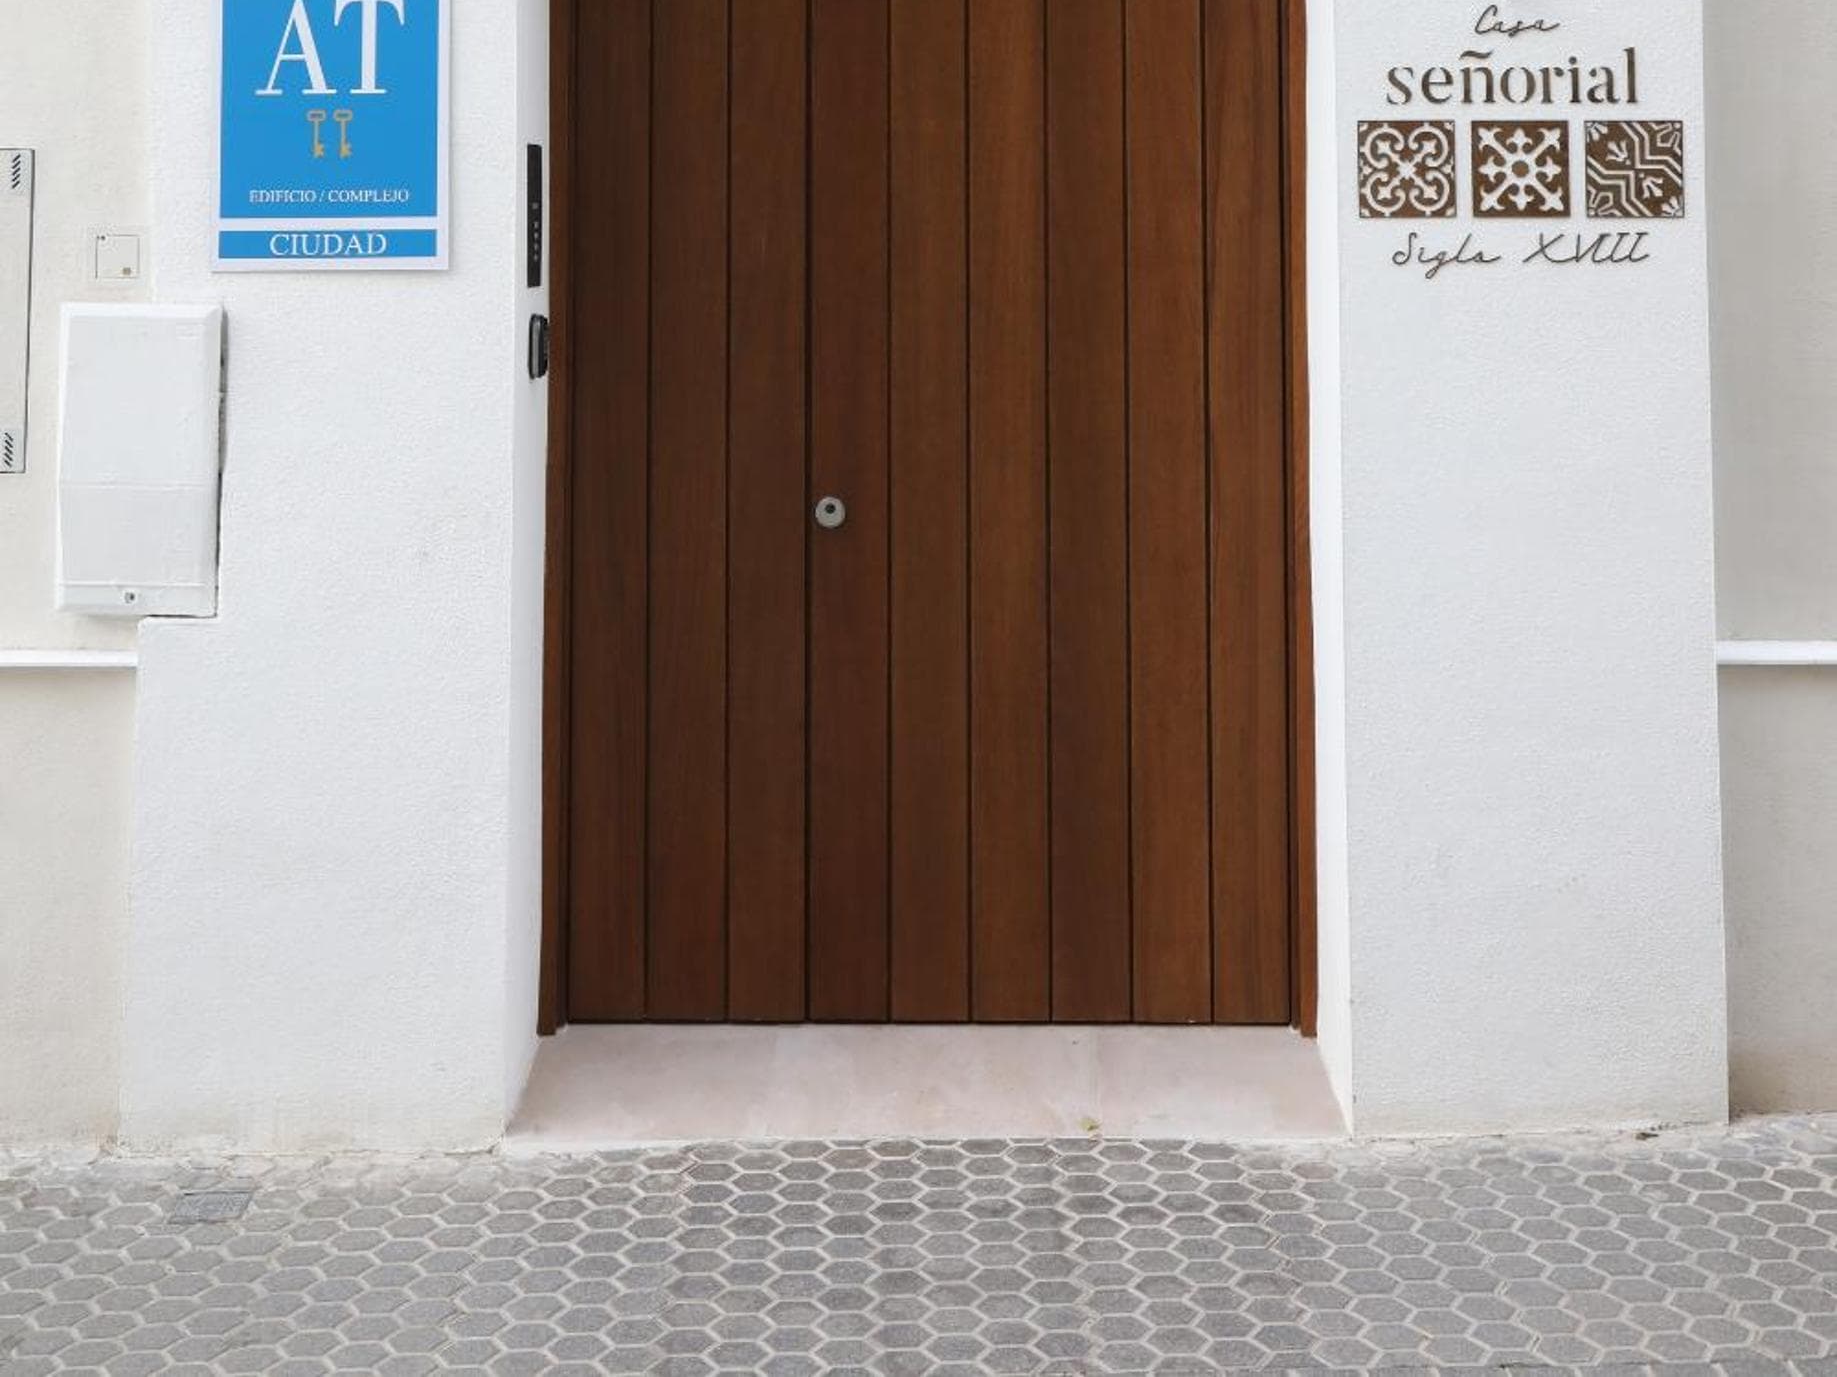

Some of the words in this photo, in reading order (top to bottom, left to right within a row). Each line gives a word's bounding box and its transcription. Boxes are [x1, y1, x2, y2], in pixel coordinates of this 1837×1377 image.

[1474, 4, 1561, 38] Casa
[1386, 47, 1638, 105] señorial
[249, 189, 317, 203] EDIFICIO
[327, 189, 409, 202] COMPLEJO
[269, 233, 387, 256] CIUDAD
[1522, 232, 1650, 263] XVIII
